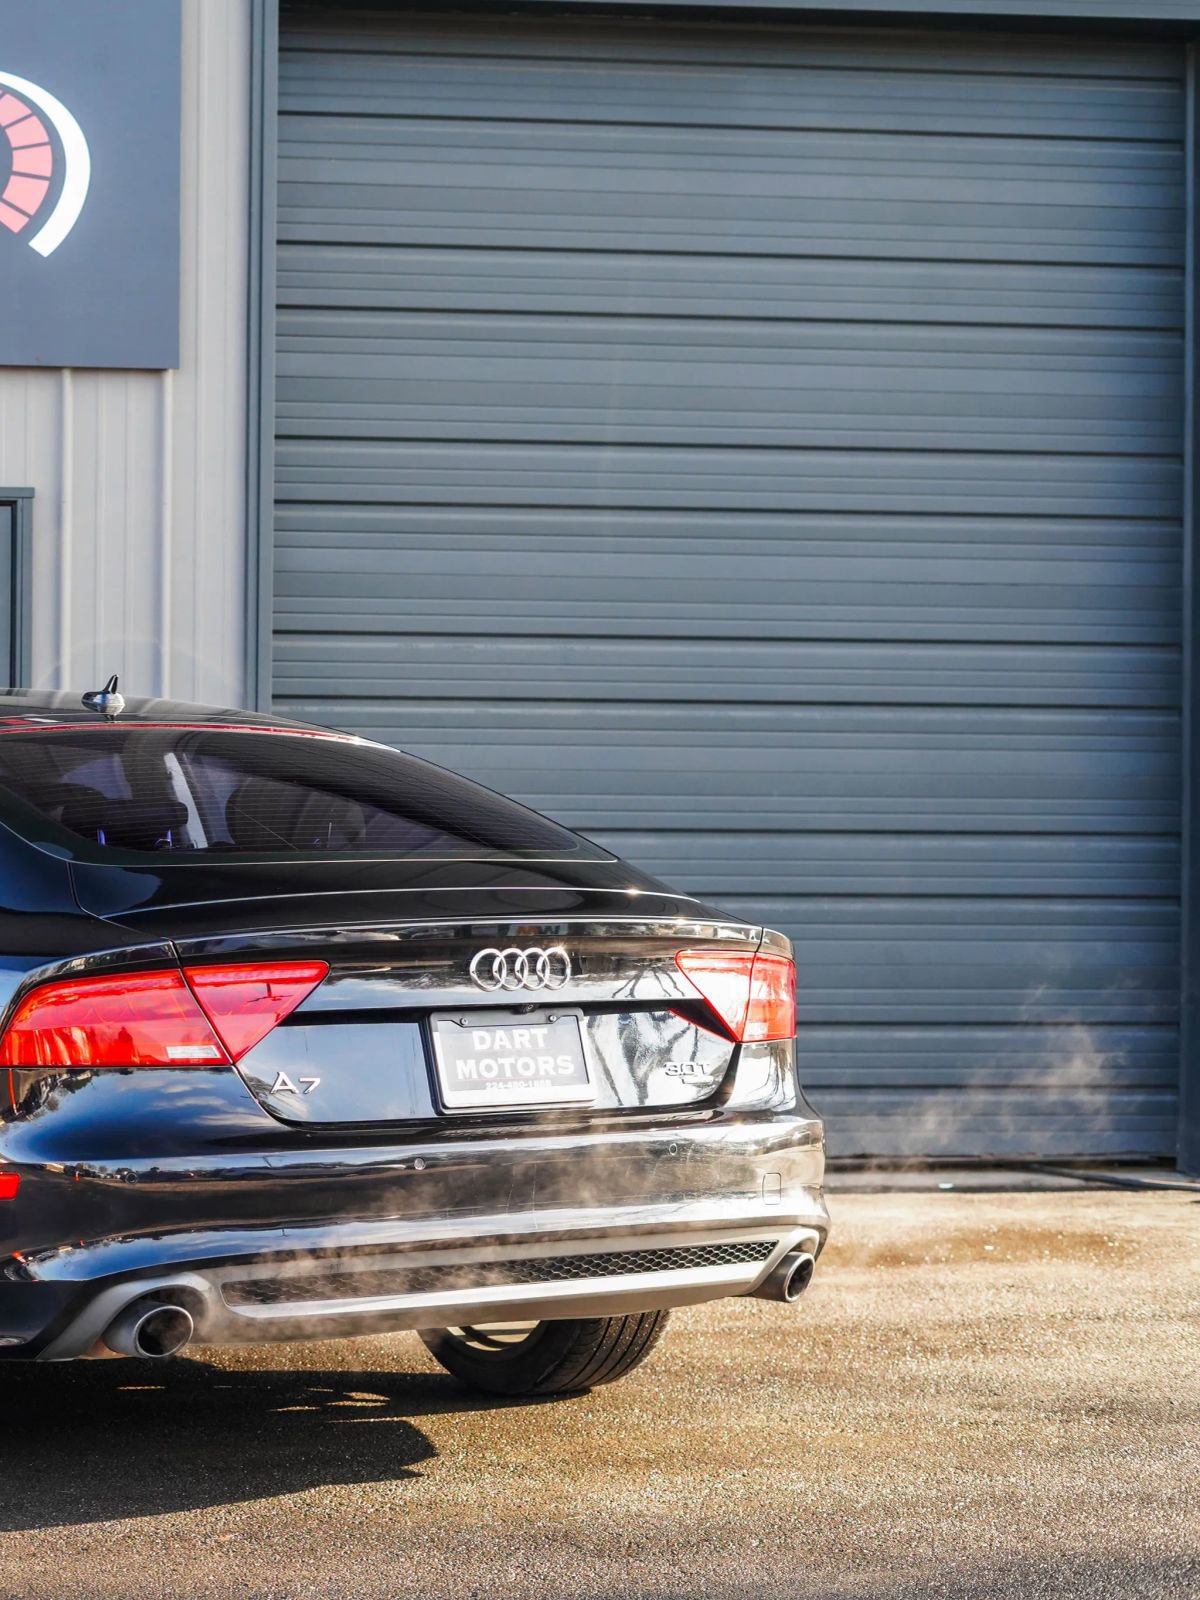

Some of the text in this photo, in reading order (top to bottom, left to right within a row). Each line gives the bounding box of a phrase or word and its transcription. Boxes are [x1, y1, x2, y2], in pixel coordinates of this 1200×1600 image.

[472, 1027, 548, 1051] DART
[455, 1055, 575, 1080] MOTORS
[269, 1071, 321, 1094] A7
